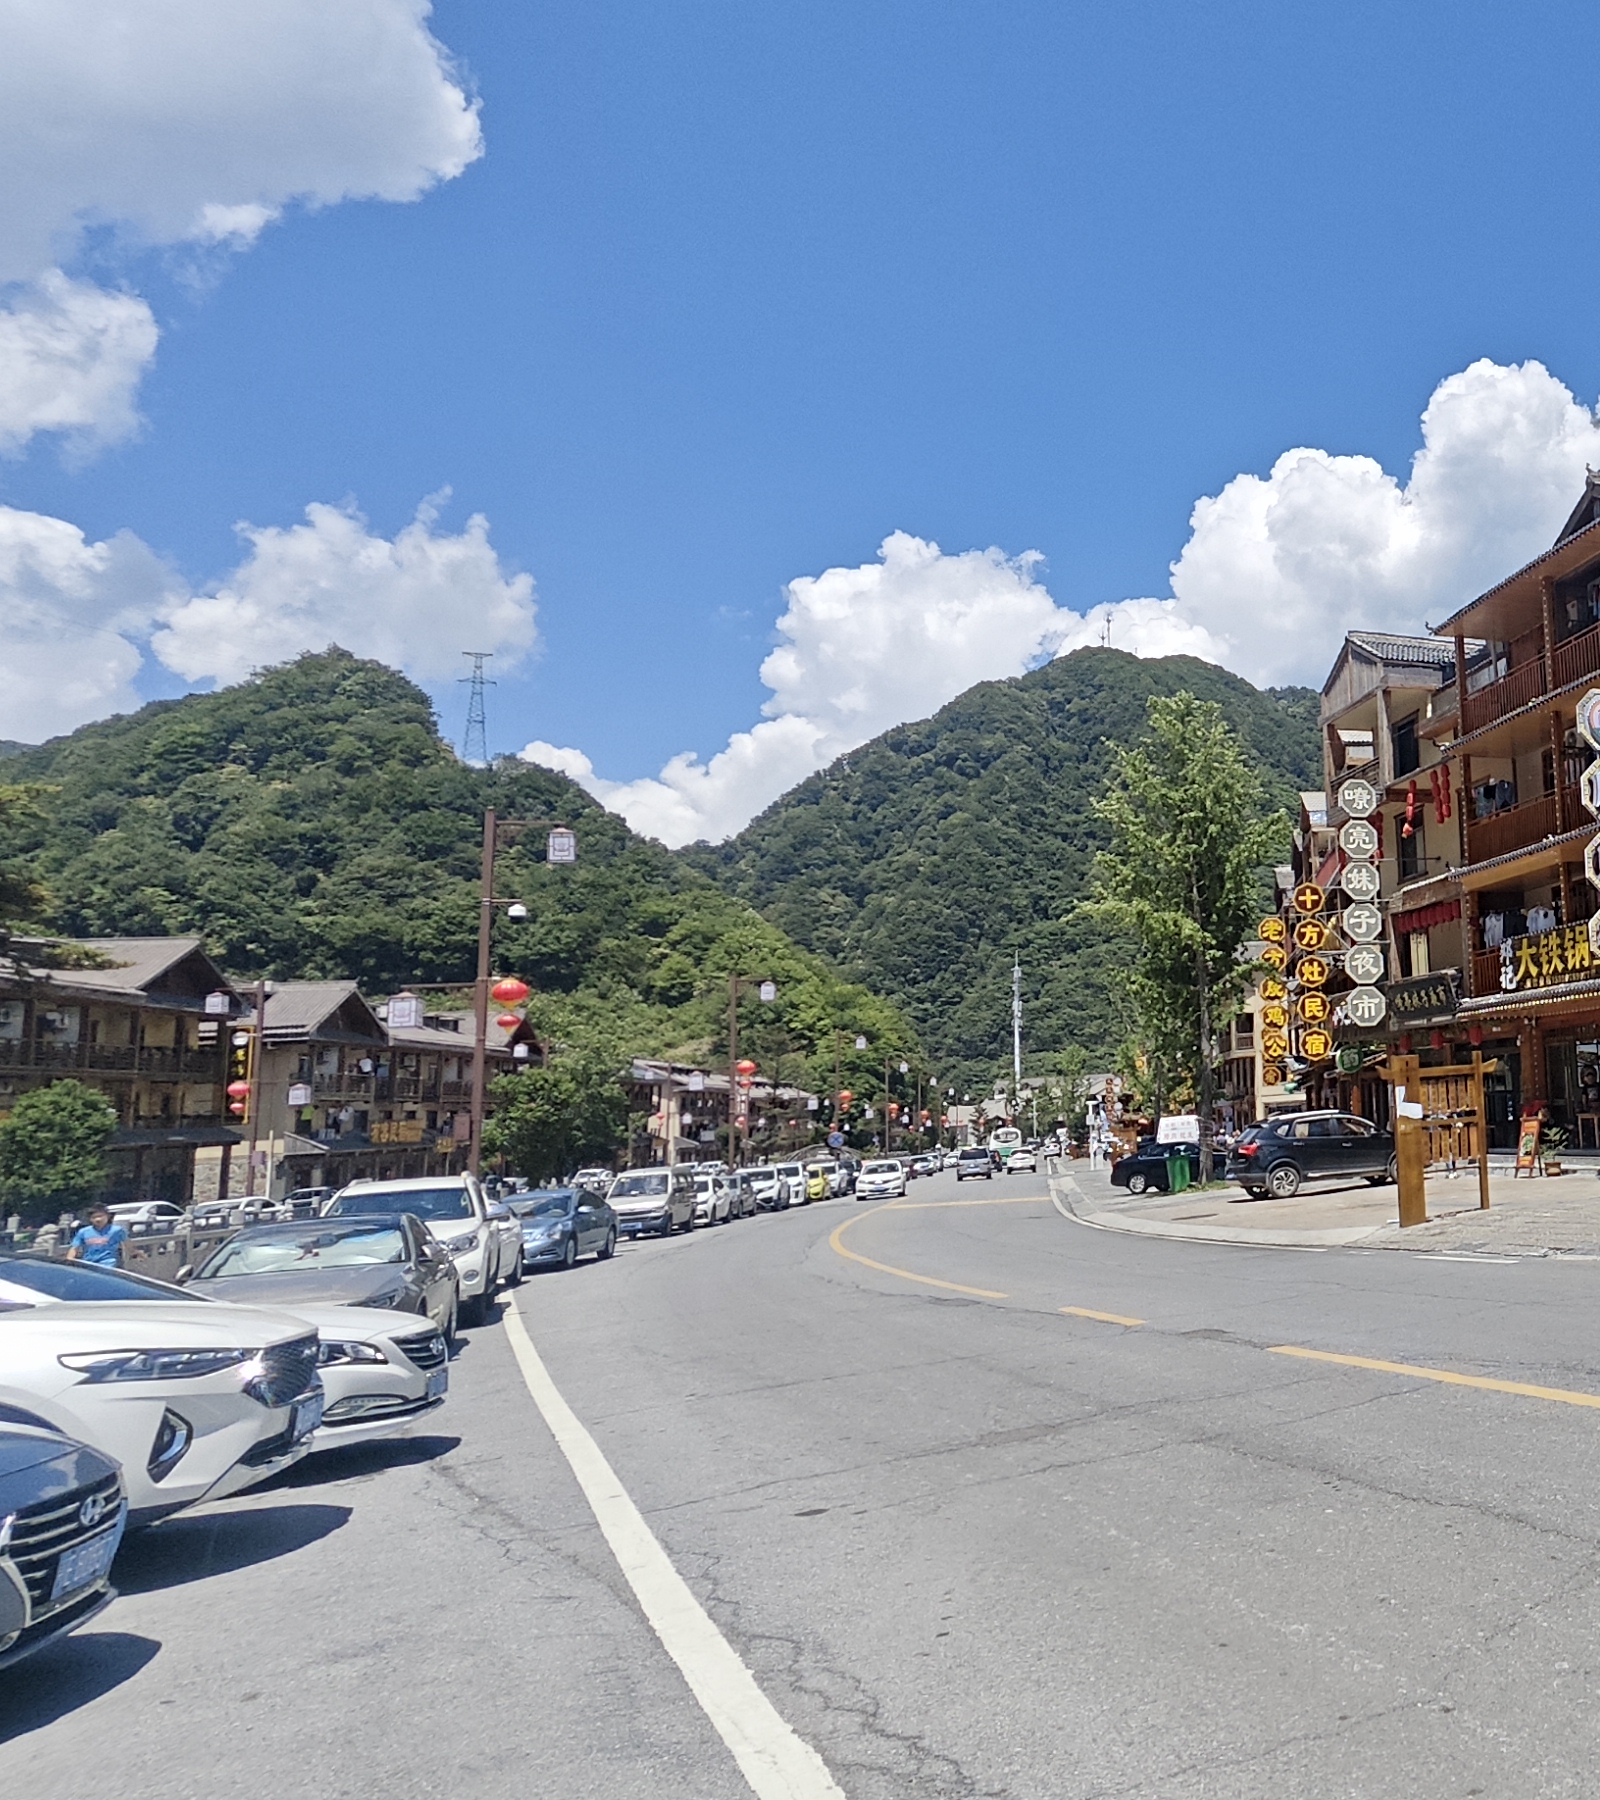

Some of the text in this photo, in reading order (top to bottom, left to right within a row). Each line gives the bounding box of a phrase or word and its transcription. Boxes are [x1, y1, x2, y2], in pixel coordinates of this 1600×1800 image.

[1297, 888, 1327, 1055] 十方灶民宿
[1343, 786, 1380, 1019] 嘹亮妹子夜市
